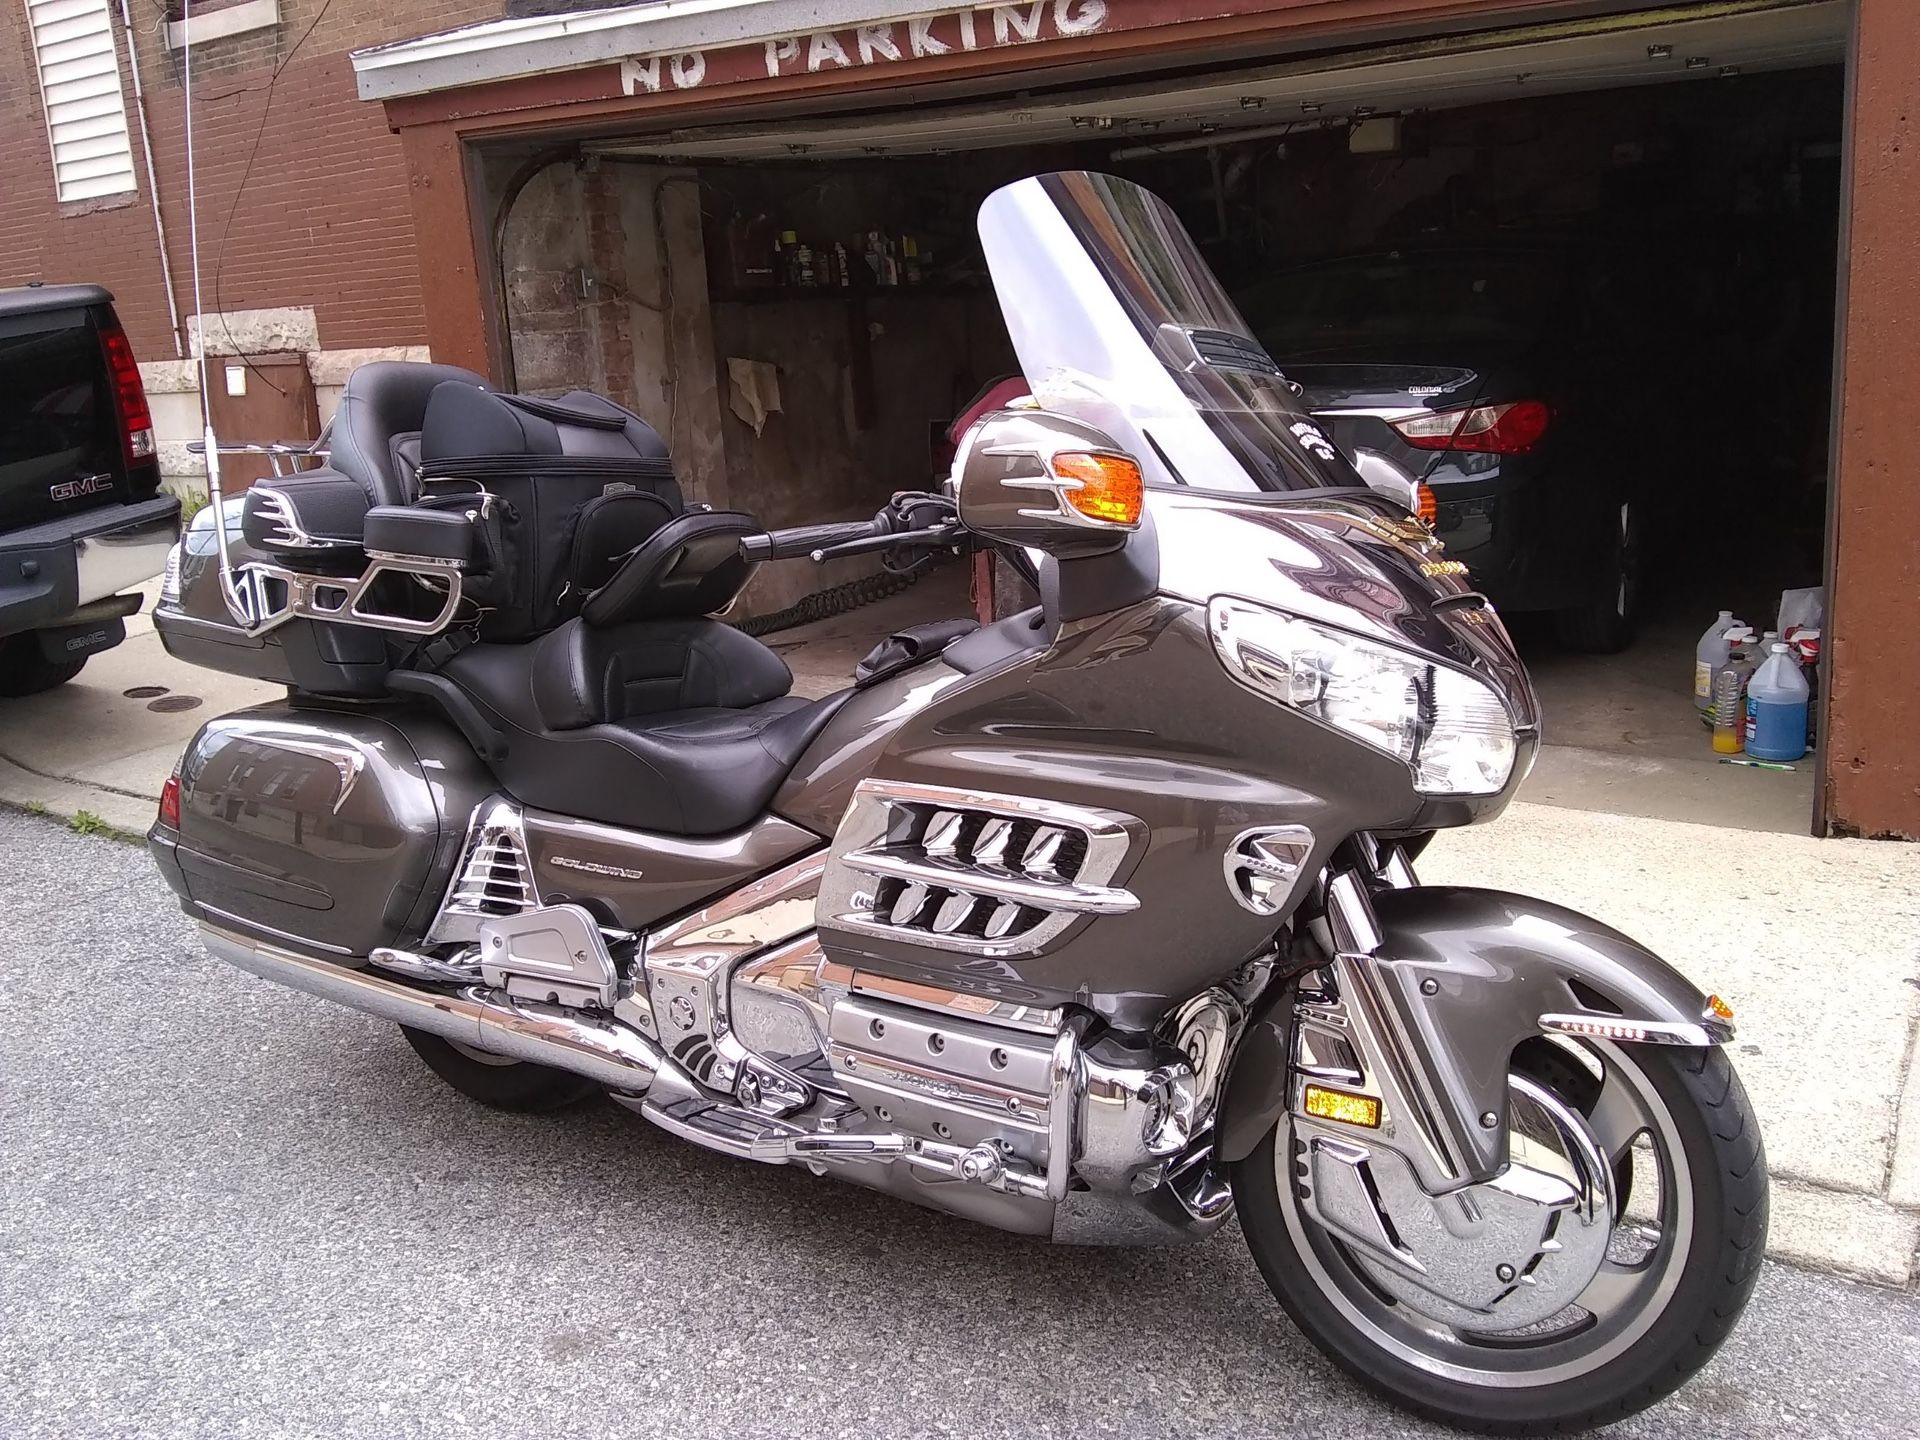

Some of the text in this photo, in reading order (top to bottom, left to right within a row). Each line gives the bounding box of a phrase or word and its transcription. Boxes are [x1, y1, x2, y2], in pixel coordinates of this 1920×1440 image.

[620, 0, 1108, 96] NO PARKING
[50, 473, 113, 501] GMC
[66, 630, 106, 650] GMC
[550, 856, 643, 879] GOLDWING
